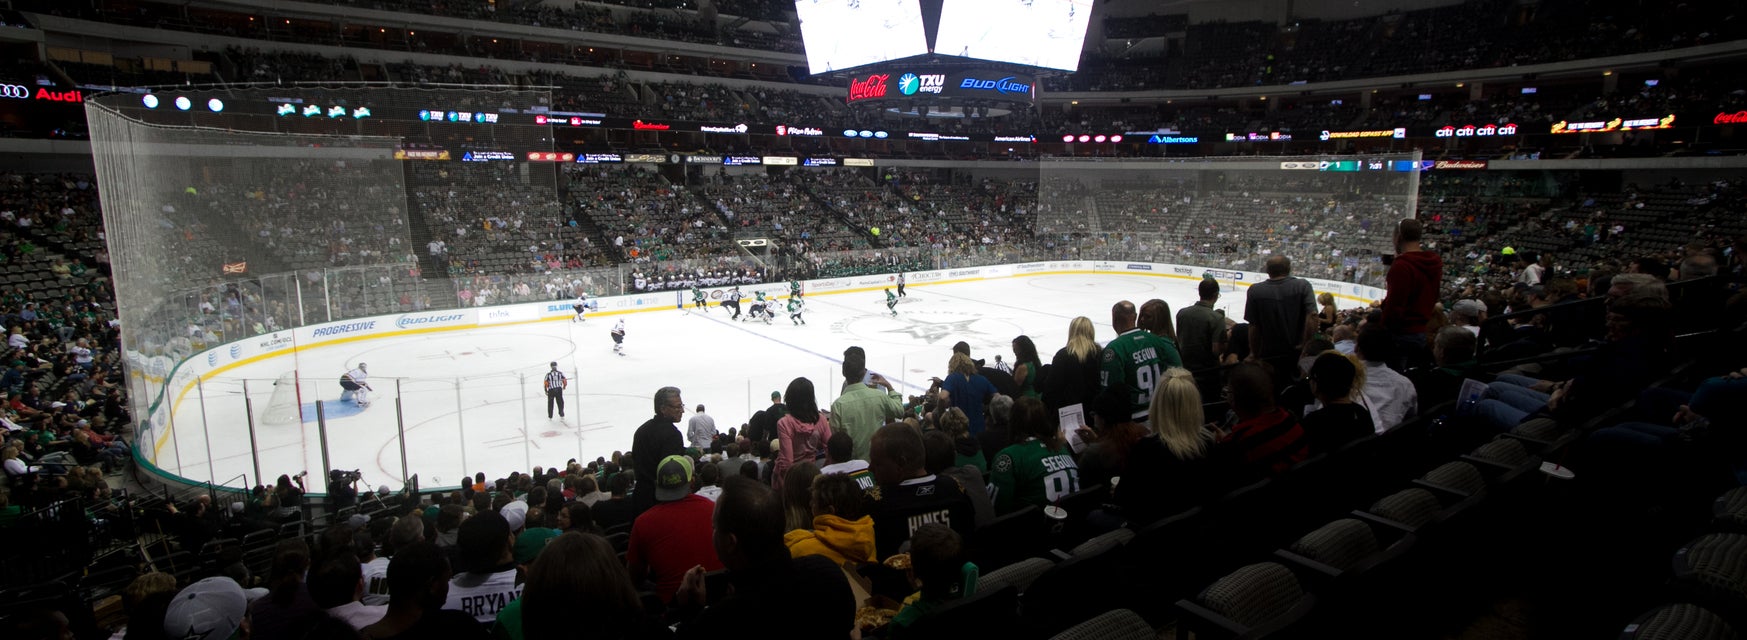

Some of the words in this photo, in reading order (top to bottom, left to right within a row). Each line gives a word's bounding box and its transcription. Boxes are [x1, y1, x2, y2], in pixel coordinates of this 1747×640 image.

[850, 74, 890, 100] Coca-Cola
[920, 74, 945, 86] TXU
[960, 78, 996, 89] BUD
[1001, 82, 1030, 93] LIGHT
[36, 88, 82, 102] Audi
[920, 85, 944, 93] energy
[1436, 161, 1485, 170] Budweiser
[401, 317, 429, 325] BUD
[430, 314, 464, 322] LIGHT
[313, 321, 376, 338] PROGRESSIVE
[1137, 364, 1160, 404] 91
